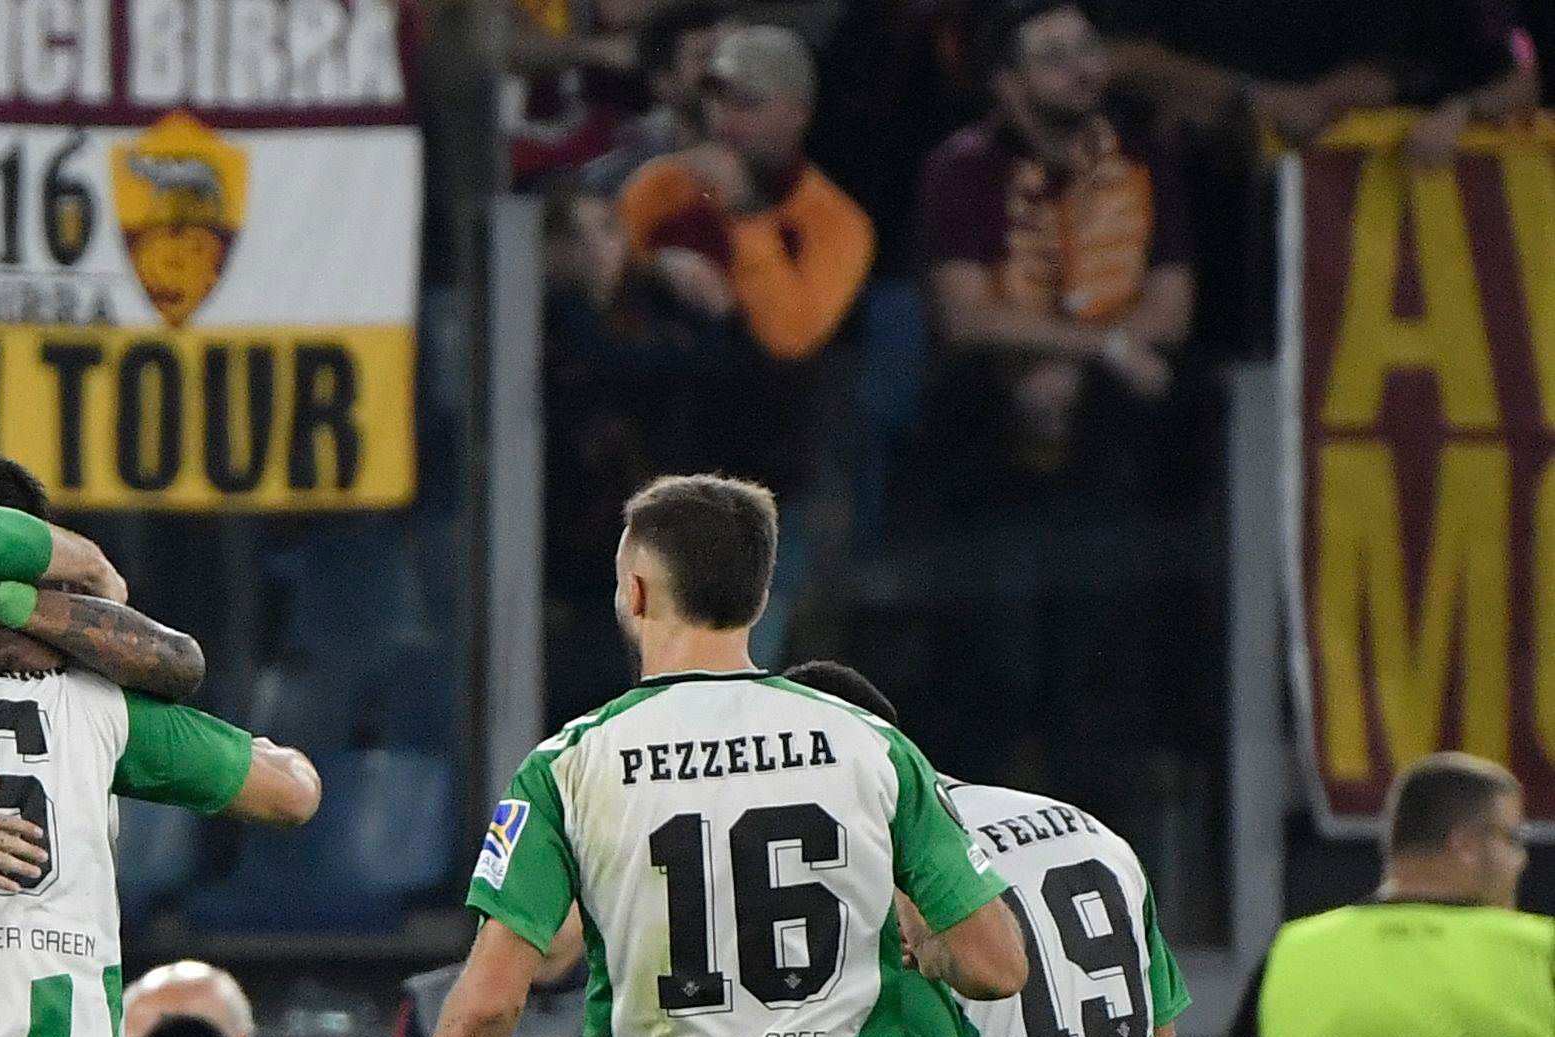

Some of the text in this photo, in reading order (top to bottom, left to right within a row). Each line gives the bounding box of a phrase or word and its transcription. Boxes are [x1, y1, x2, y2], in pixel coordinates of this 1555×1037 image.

[129, 0, 409, 106] BIRRA
[42, 340, 364, 493] TOUR
[1316, 443, 1555, 780] M
[619, 730, 838, 785] PEZZELLA
[31, 928, 97, 958] GREEN
[648, 802, 848, 1017] 16
